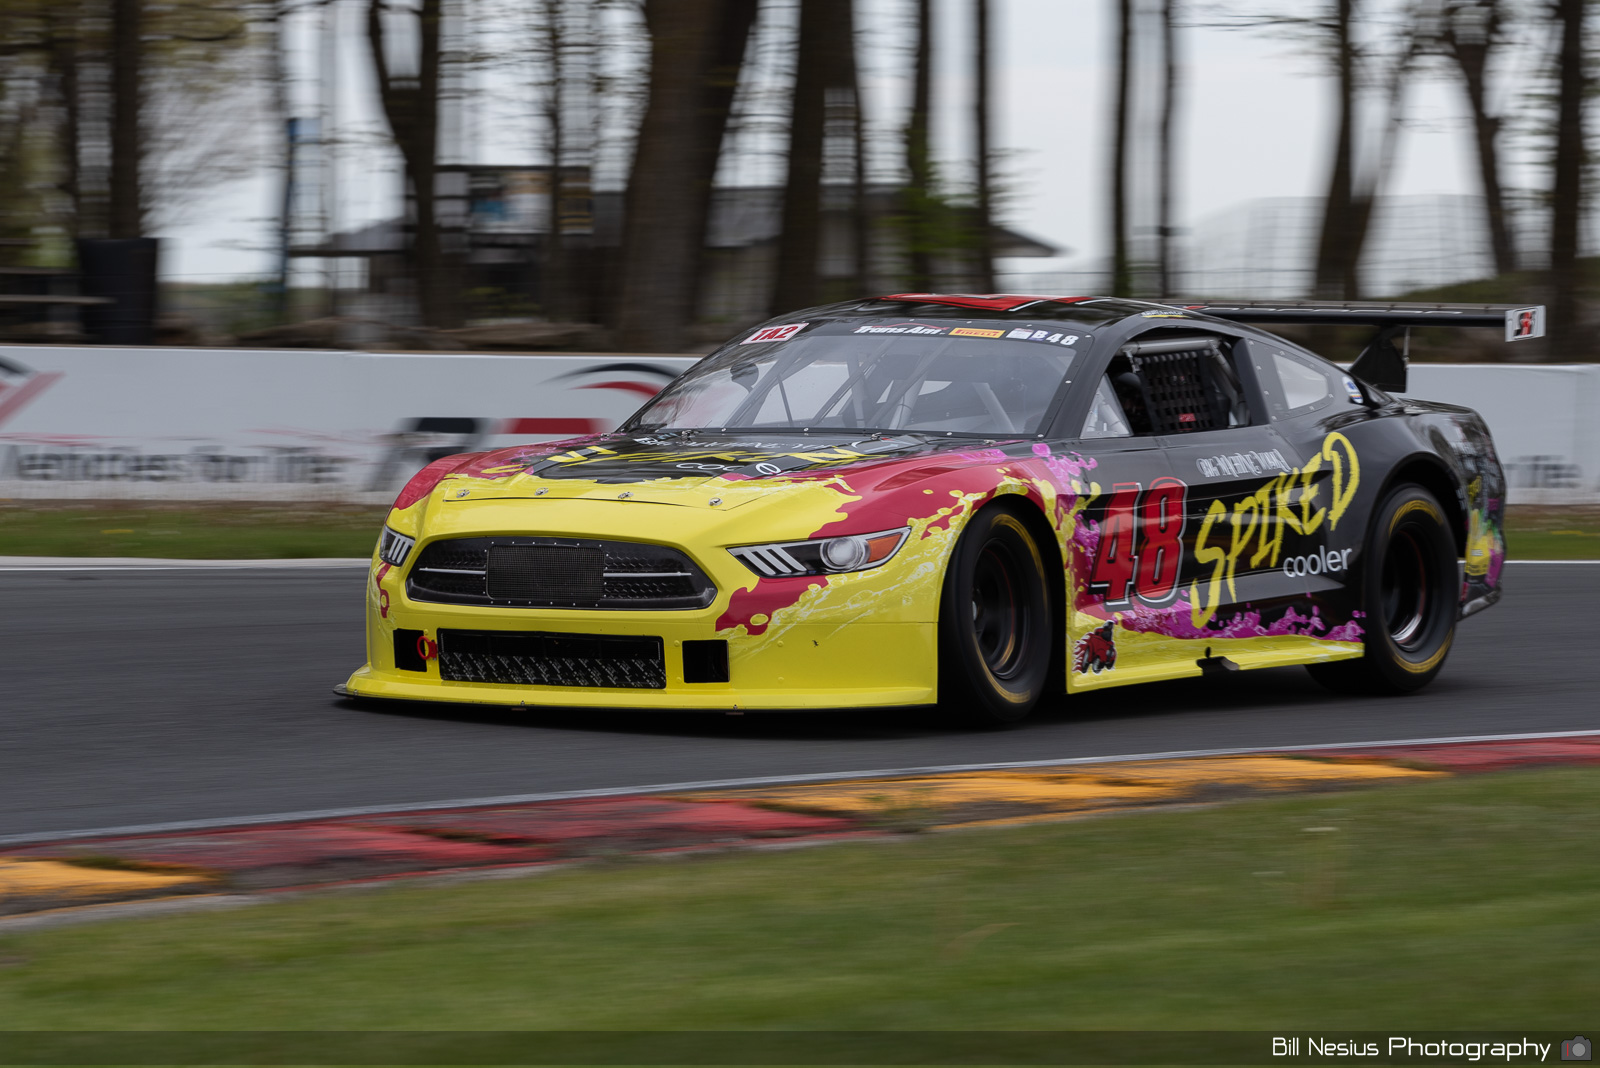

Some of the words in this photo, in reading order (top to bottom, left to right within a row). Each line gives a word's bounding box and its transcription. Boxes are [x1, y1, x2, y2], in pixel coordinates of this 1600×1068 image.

[751, 326, 799, 341] TA2
[853, 326, 904, 334] Trans
[904, 326, 942, 335] Am
[954, 329, 1000, 337] PIRELLI
[1046, 333, 1079, 346] 48
[1189, 431, 1360, 629] SPIKED
[1088, 476, 1188, 607] 48
[1283, 545, 1353, 578] cooler
